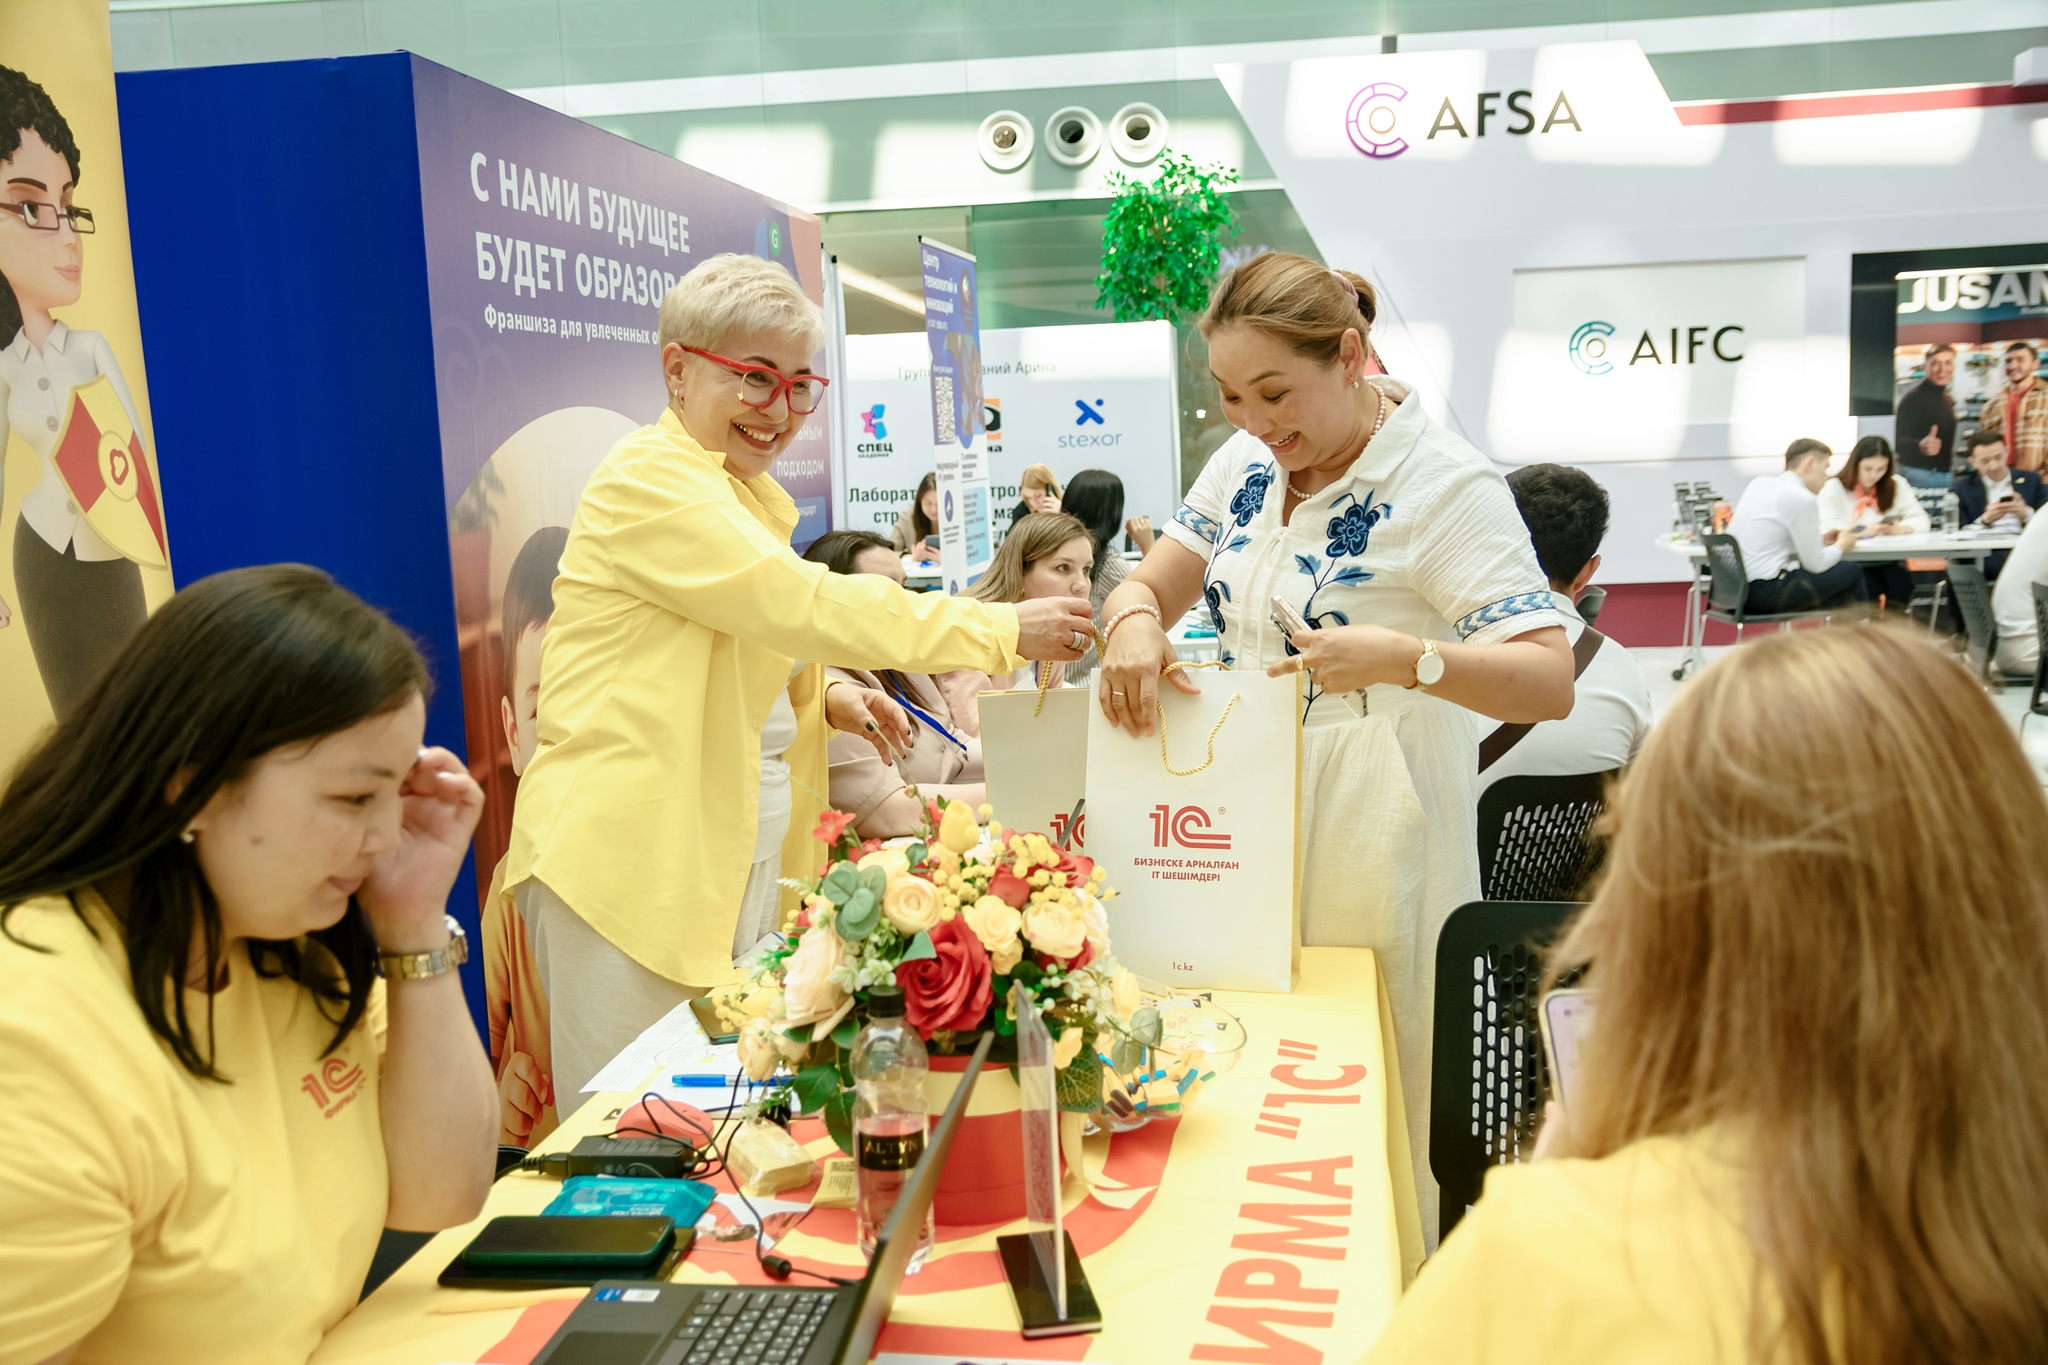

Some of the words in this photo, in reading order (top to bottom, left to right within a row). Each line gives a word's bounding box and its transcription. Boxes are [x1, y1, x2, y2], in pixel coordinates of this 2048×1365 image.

[1427, 89, 1583, 140] AFSA
[470, 152, 490, 202] С
[498, 159, 581, 226] НАМИ
[588, 186, 691, 257] БУДУЩЕЕ
[475, 231, 567, 299] БУДЕТ
[575, 252, 684, 309] ОБРАЗО
[484, 303, 557, 334] Франшиза
[560, 319, 583, 339] для
[585, 322, 650, 343] увлеченных
[1628, 325, 1746, 367] AIFC
[857, 443, 893, 453] СПЕЦ
[1058, 430, 1123, 449] stexor
[776, 458, 825, 481] подходом
[1134, 857, 1184, 868] БИЗНЕСКЕ
[1185, 859, 1239, 870] АРНАЛҒАН
[1172, 961, 1194, 971] 1c.kz
